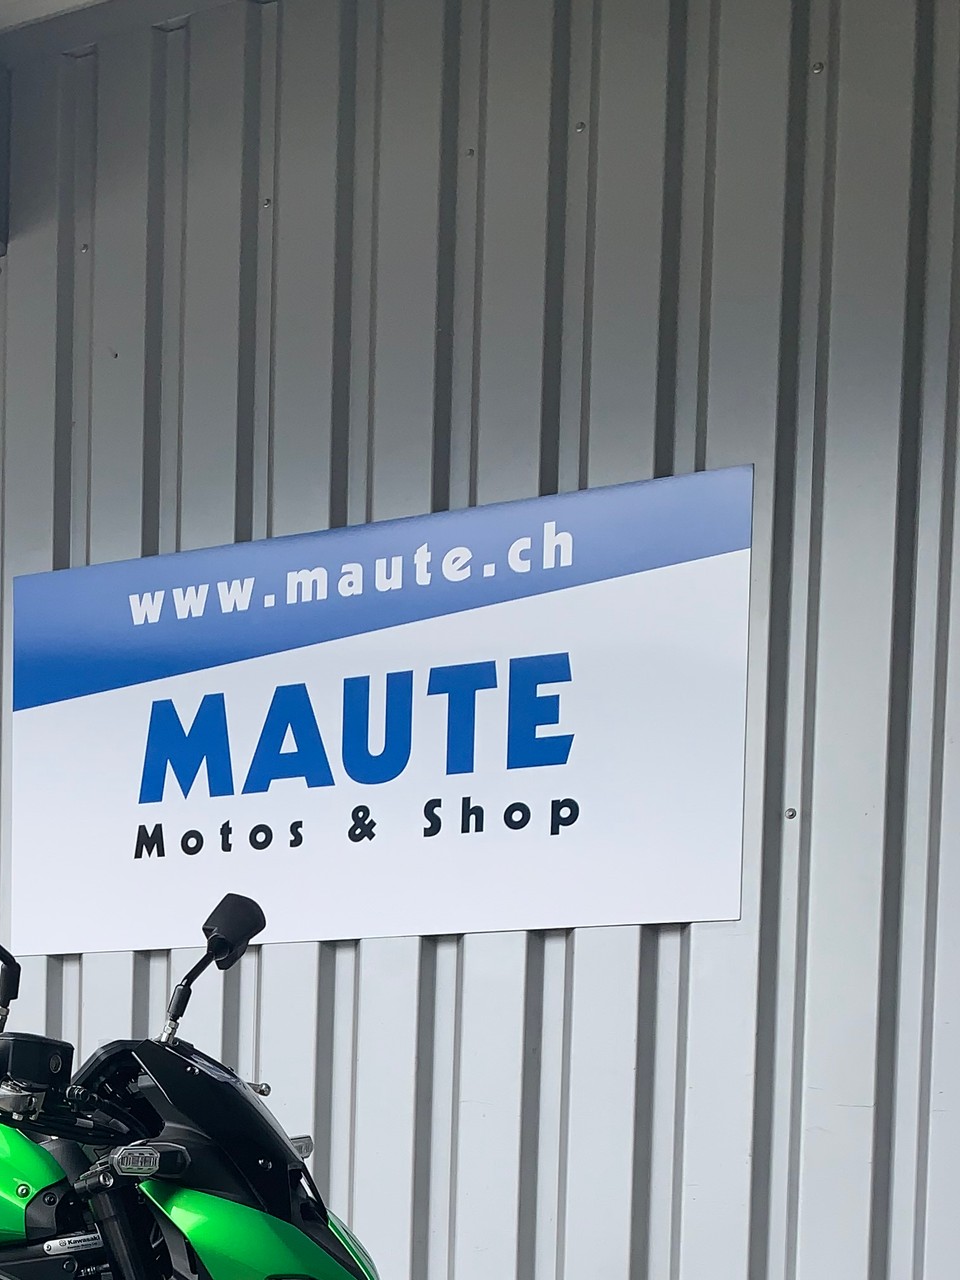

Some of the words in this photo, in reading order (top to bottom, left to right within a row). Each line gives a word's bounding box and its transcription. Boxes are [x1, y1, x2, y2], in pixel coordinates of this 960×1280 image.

[129, 521, 573, 626] www.maute.ch
[138, 652, 575, 804] MAUTE
[134, 820, 303, 860] Motos
[347, 804, 377, 842] &
[423, 797, 580, 837] Shop
